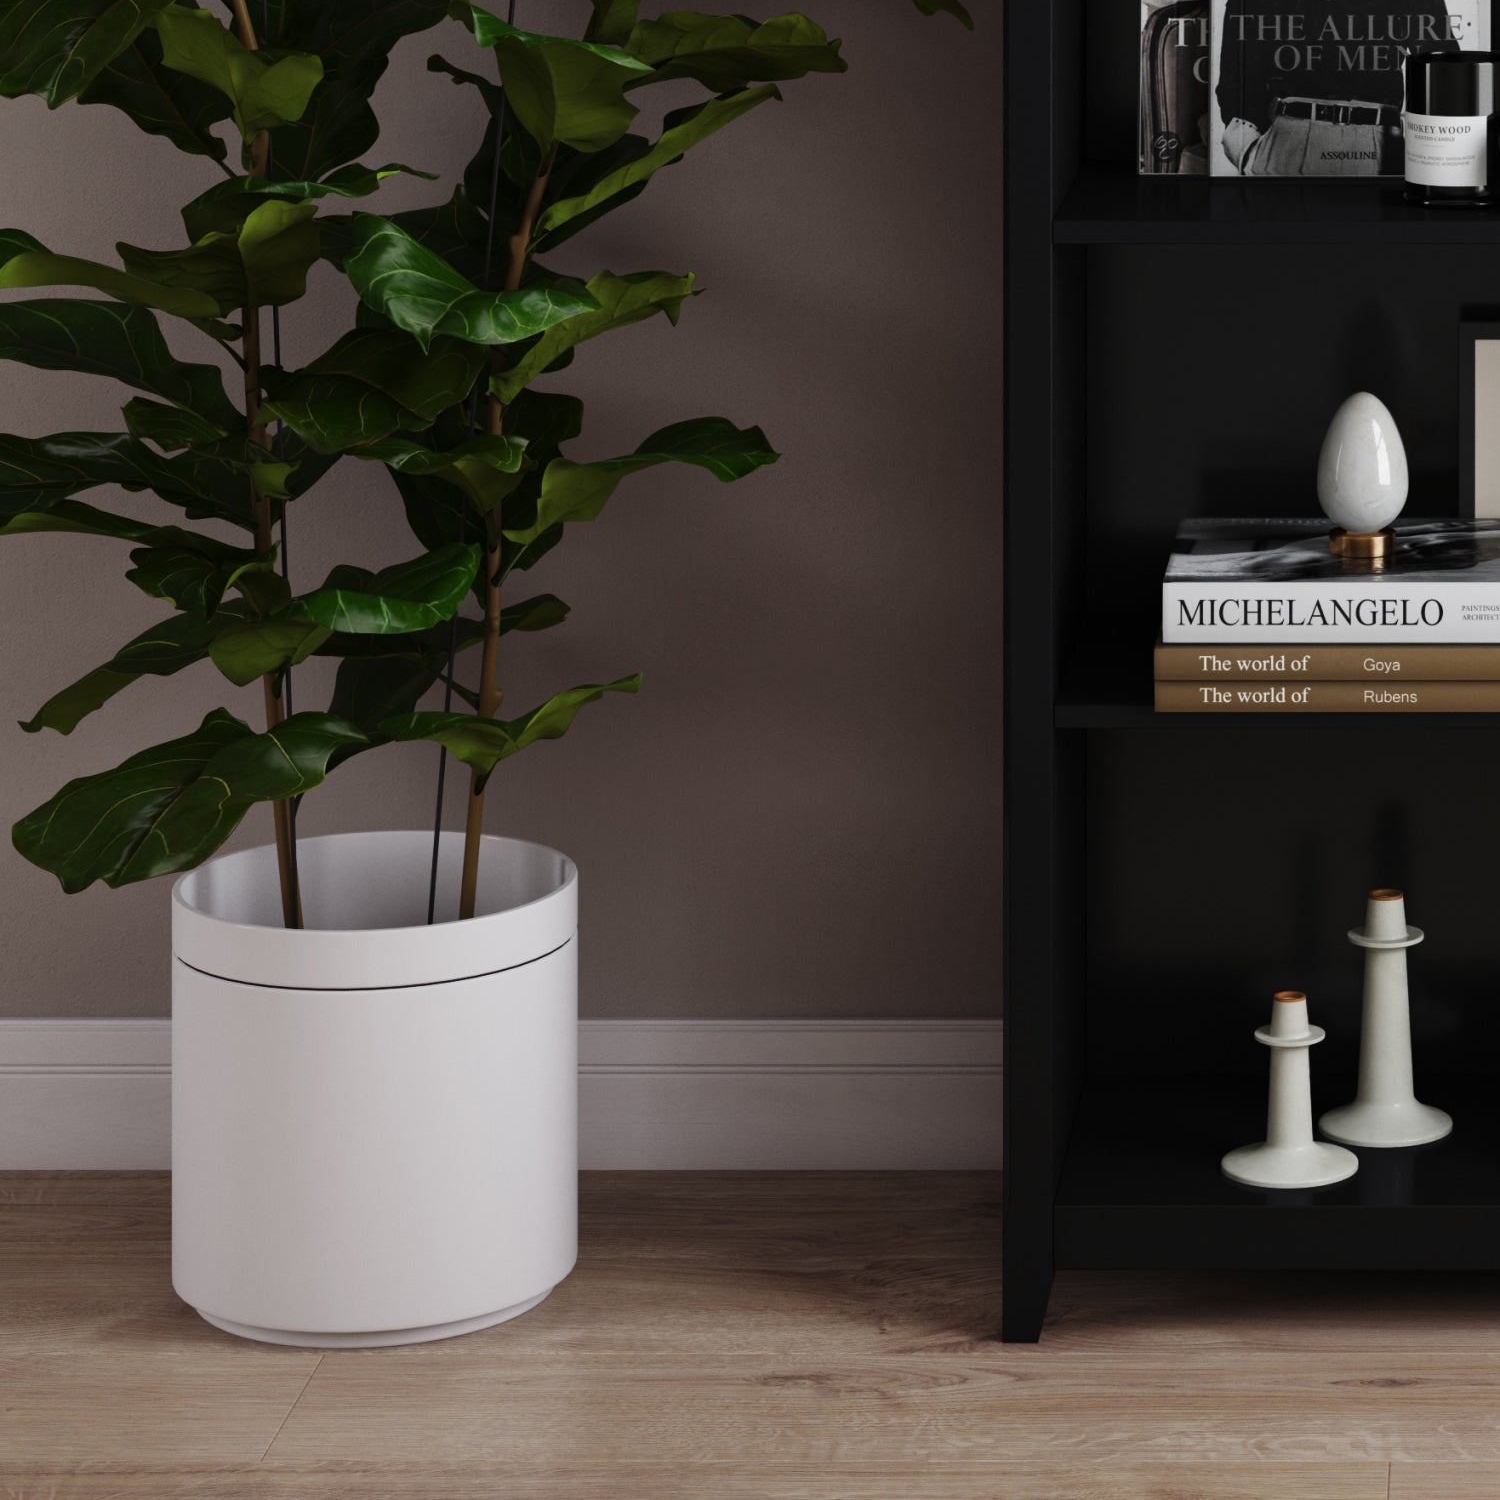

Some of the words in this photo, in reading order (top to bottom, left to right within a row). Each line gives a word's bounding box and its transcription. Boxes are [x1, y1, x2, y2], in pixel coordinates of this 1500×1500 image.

[1229, 14, 1306, 41] THE
[1318, 14, 1465, 42] ALLURE
[1273, 45, 1324, 72] OF
[1336, 45, 1422, 72] MEN
[1438, 125, 1471, 134] WOOD
[1319, 151, 1377, 161] ASSOULINE
[1177, 598, 1444, 627] MICHELANGELO
[1198, 654, 1232, 671] The
[1236, 654, 1286, 671] world
[1290, 654, 1311, 672] of
[1363, 657, 1401, 674] Goya
[1199, 687, 1232, 703] The
[1236, 686, 1286, 704] world
[1290, 686, 1312, 703] of
[1363, 690, 1418, 704] Rubens
